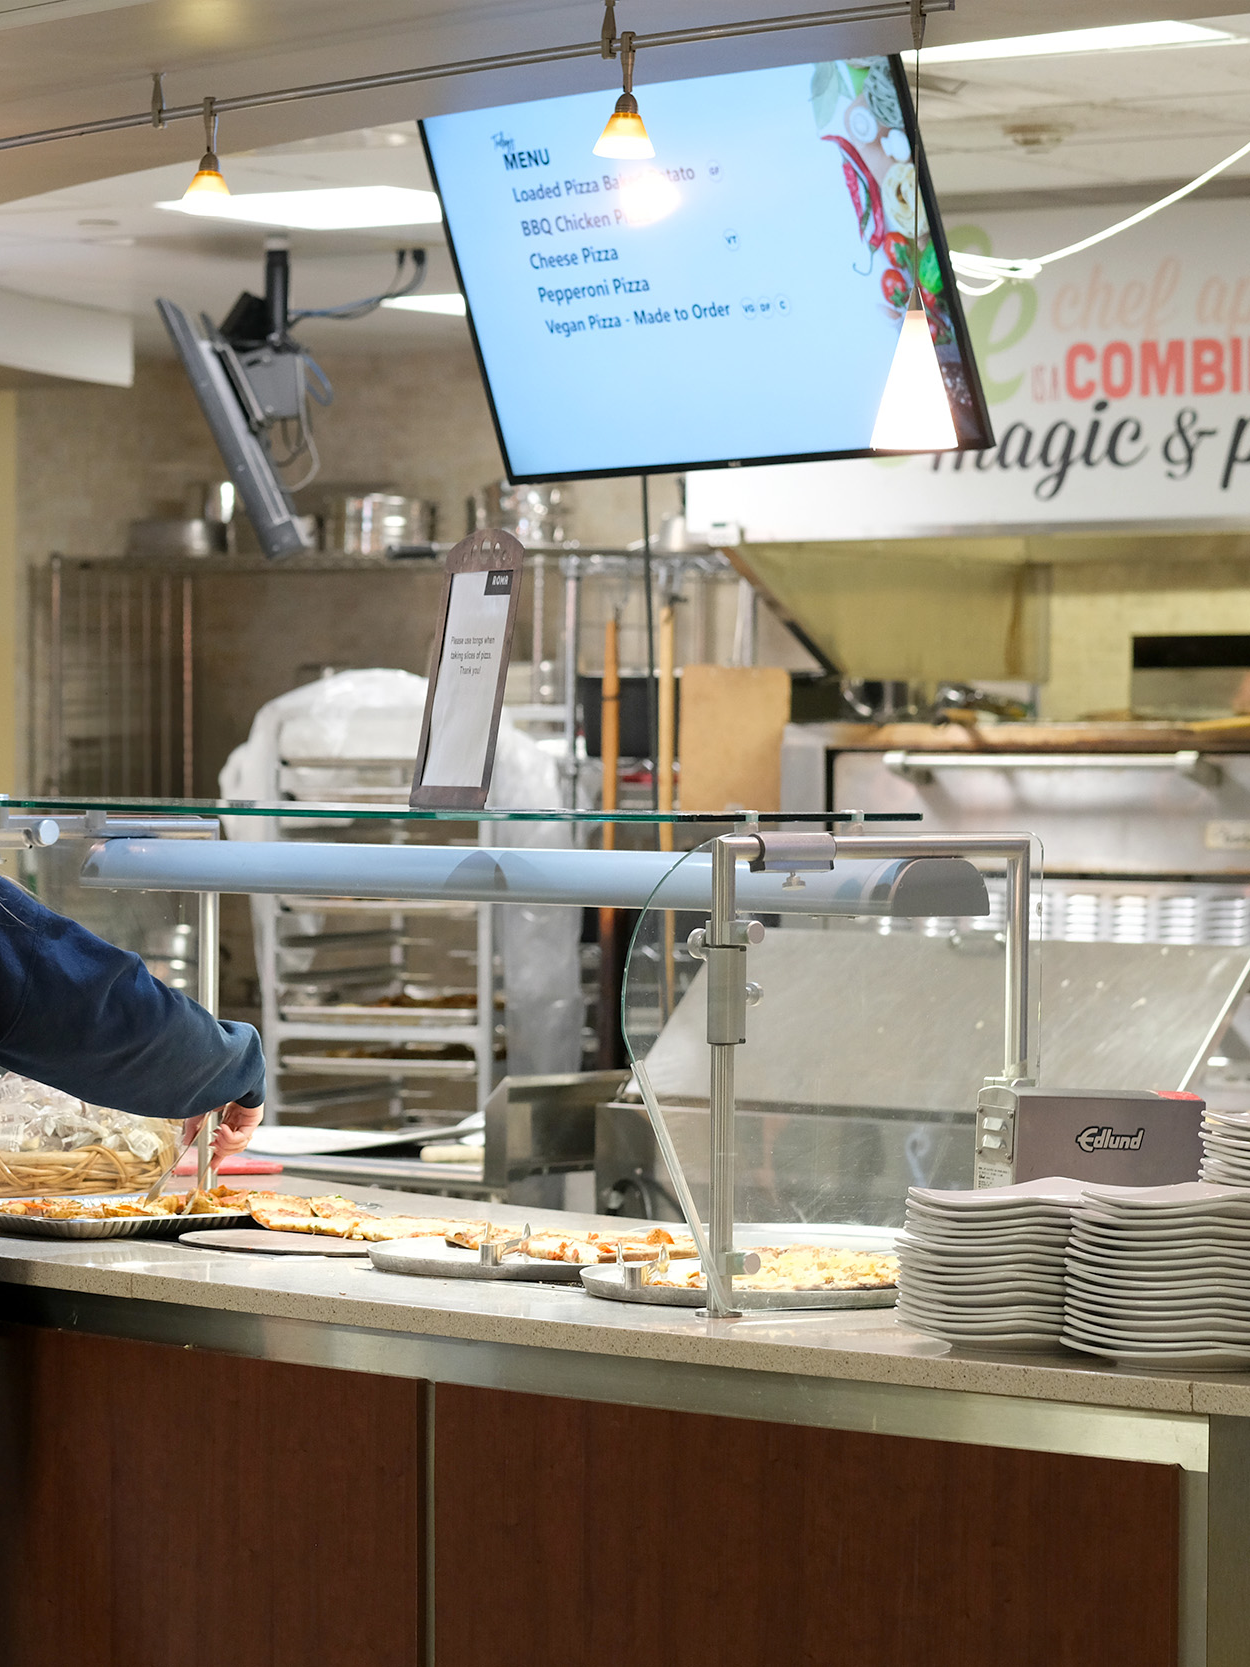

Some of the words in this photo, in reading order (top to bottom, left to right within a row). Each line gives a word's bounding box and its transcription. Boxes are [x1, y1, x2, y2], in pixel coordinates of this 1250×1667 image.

[504, 149, 550, 170] MENU
[513, 182, 562, 203] Loaded
[564, 179, 600, 197] Pizza
[521, 217, 553, 236] BBQ
[555, 213, 611, 233] Chicken
[529, 250, 579, 270] Cheese
[582, 247, 619, 264] Pizza
[537, 280, 610, 306] Pepperoni
[613, 277, 650, 295] Pizza
[1052, 255, 1182, 340] chef
[545, 317, 586, 338] Vegan
[589, 313, 622, 330] Pizza
[634, 309, 672, 326] Made
[674, 308, 689, 321] to
[692, 302, 731, 319] Order
[1065, 336, 1250, 402] COMBI
[1076, 1126, 1145, 1153] Edlund
